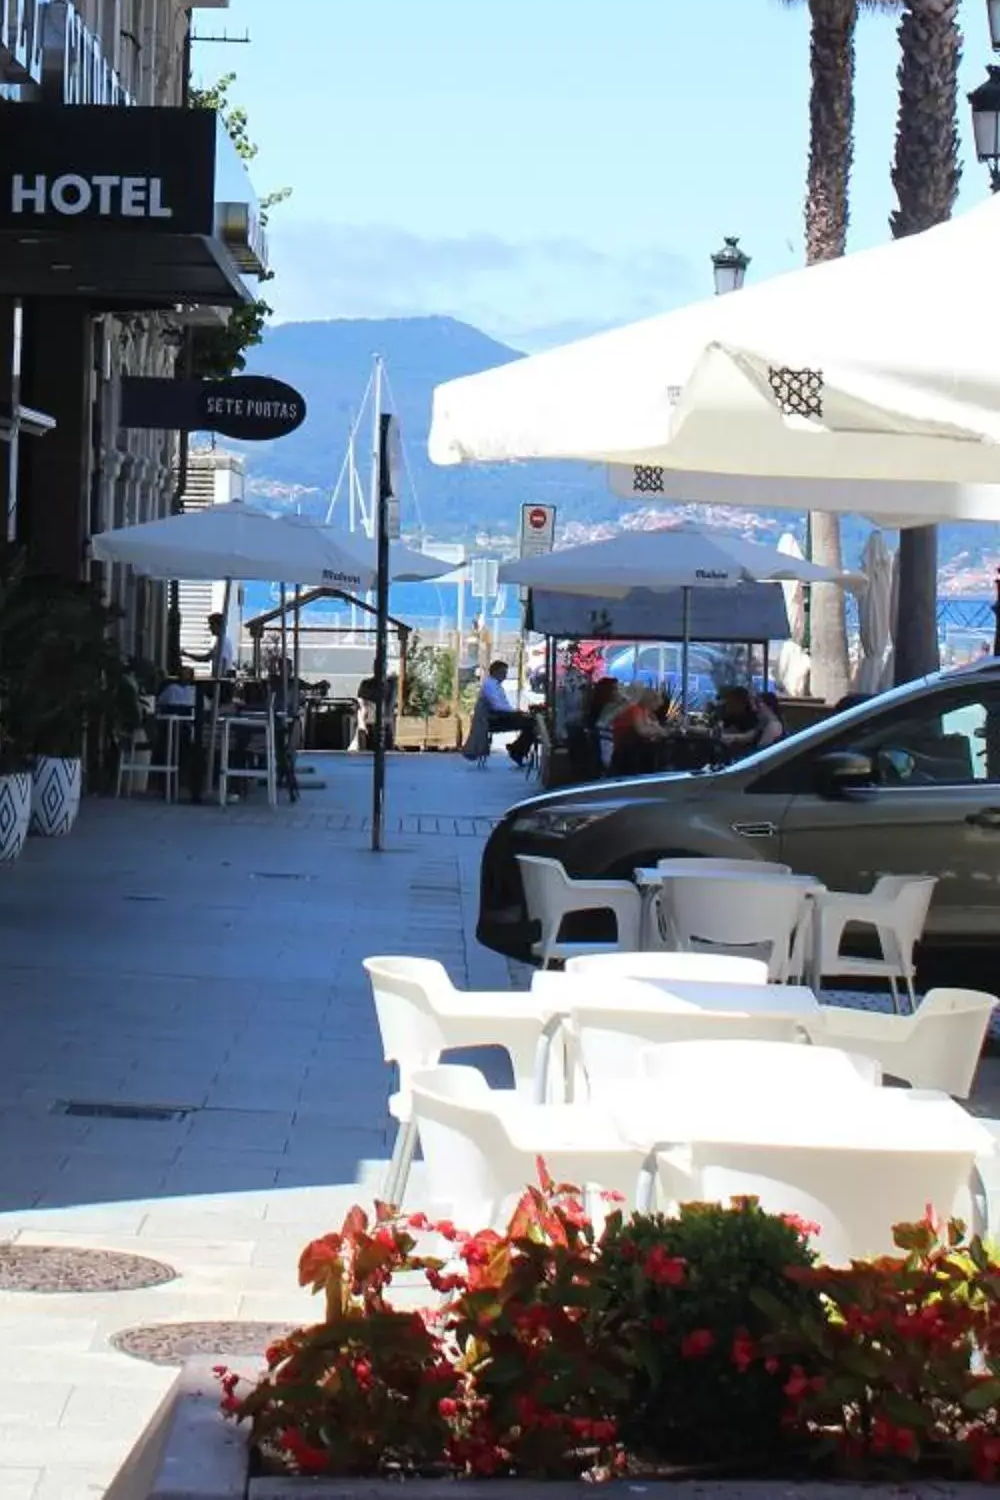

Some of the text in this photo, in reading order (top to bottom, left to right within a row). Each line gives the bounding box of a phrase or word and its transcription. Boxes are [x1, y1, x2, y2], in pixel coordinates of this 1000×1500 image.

[11, 173, 173, 218] HOTEL
[207, 396, 298, 420] SETE PORTAS
